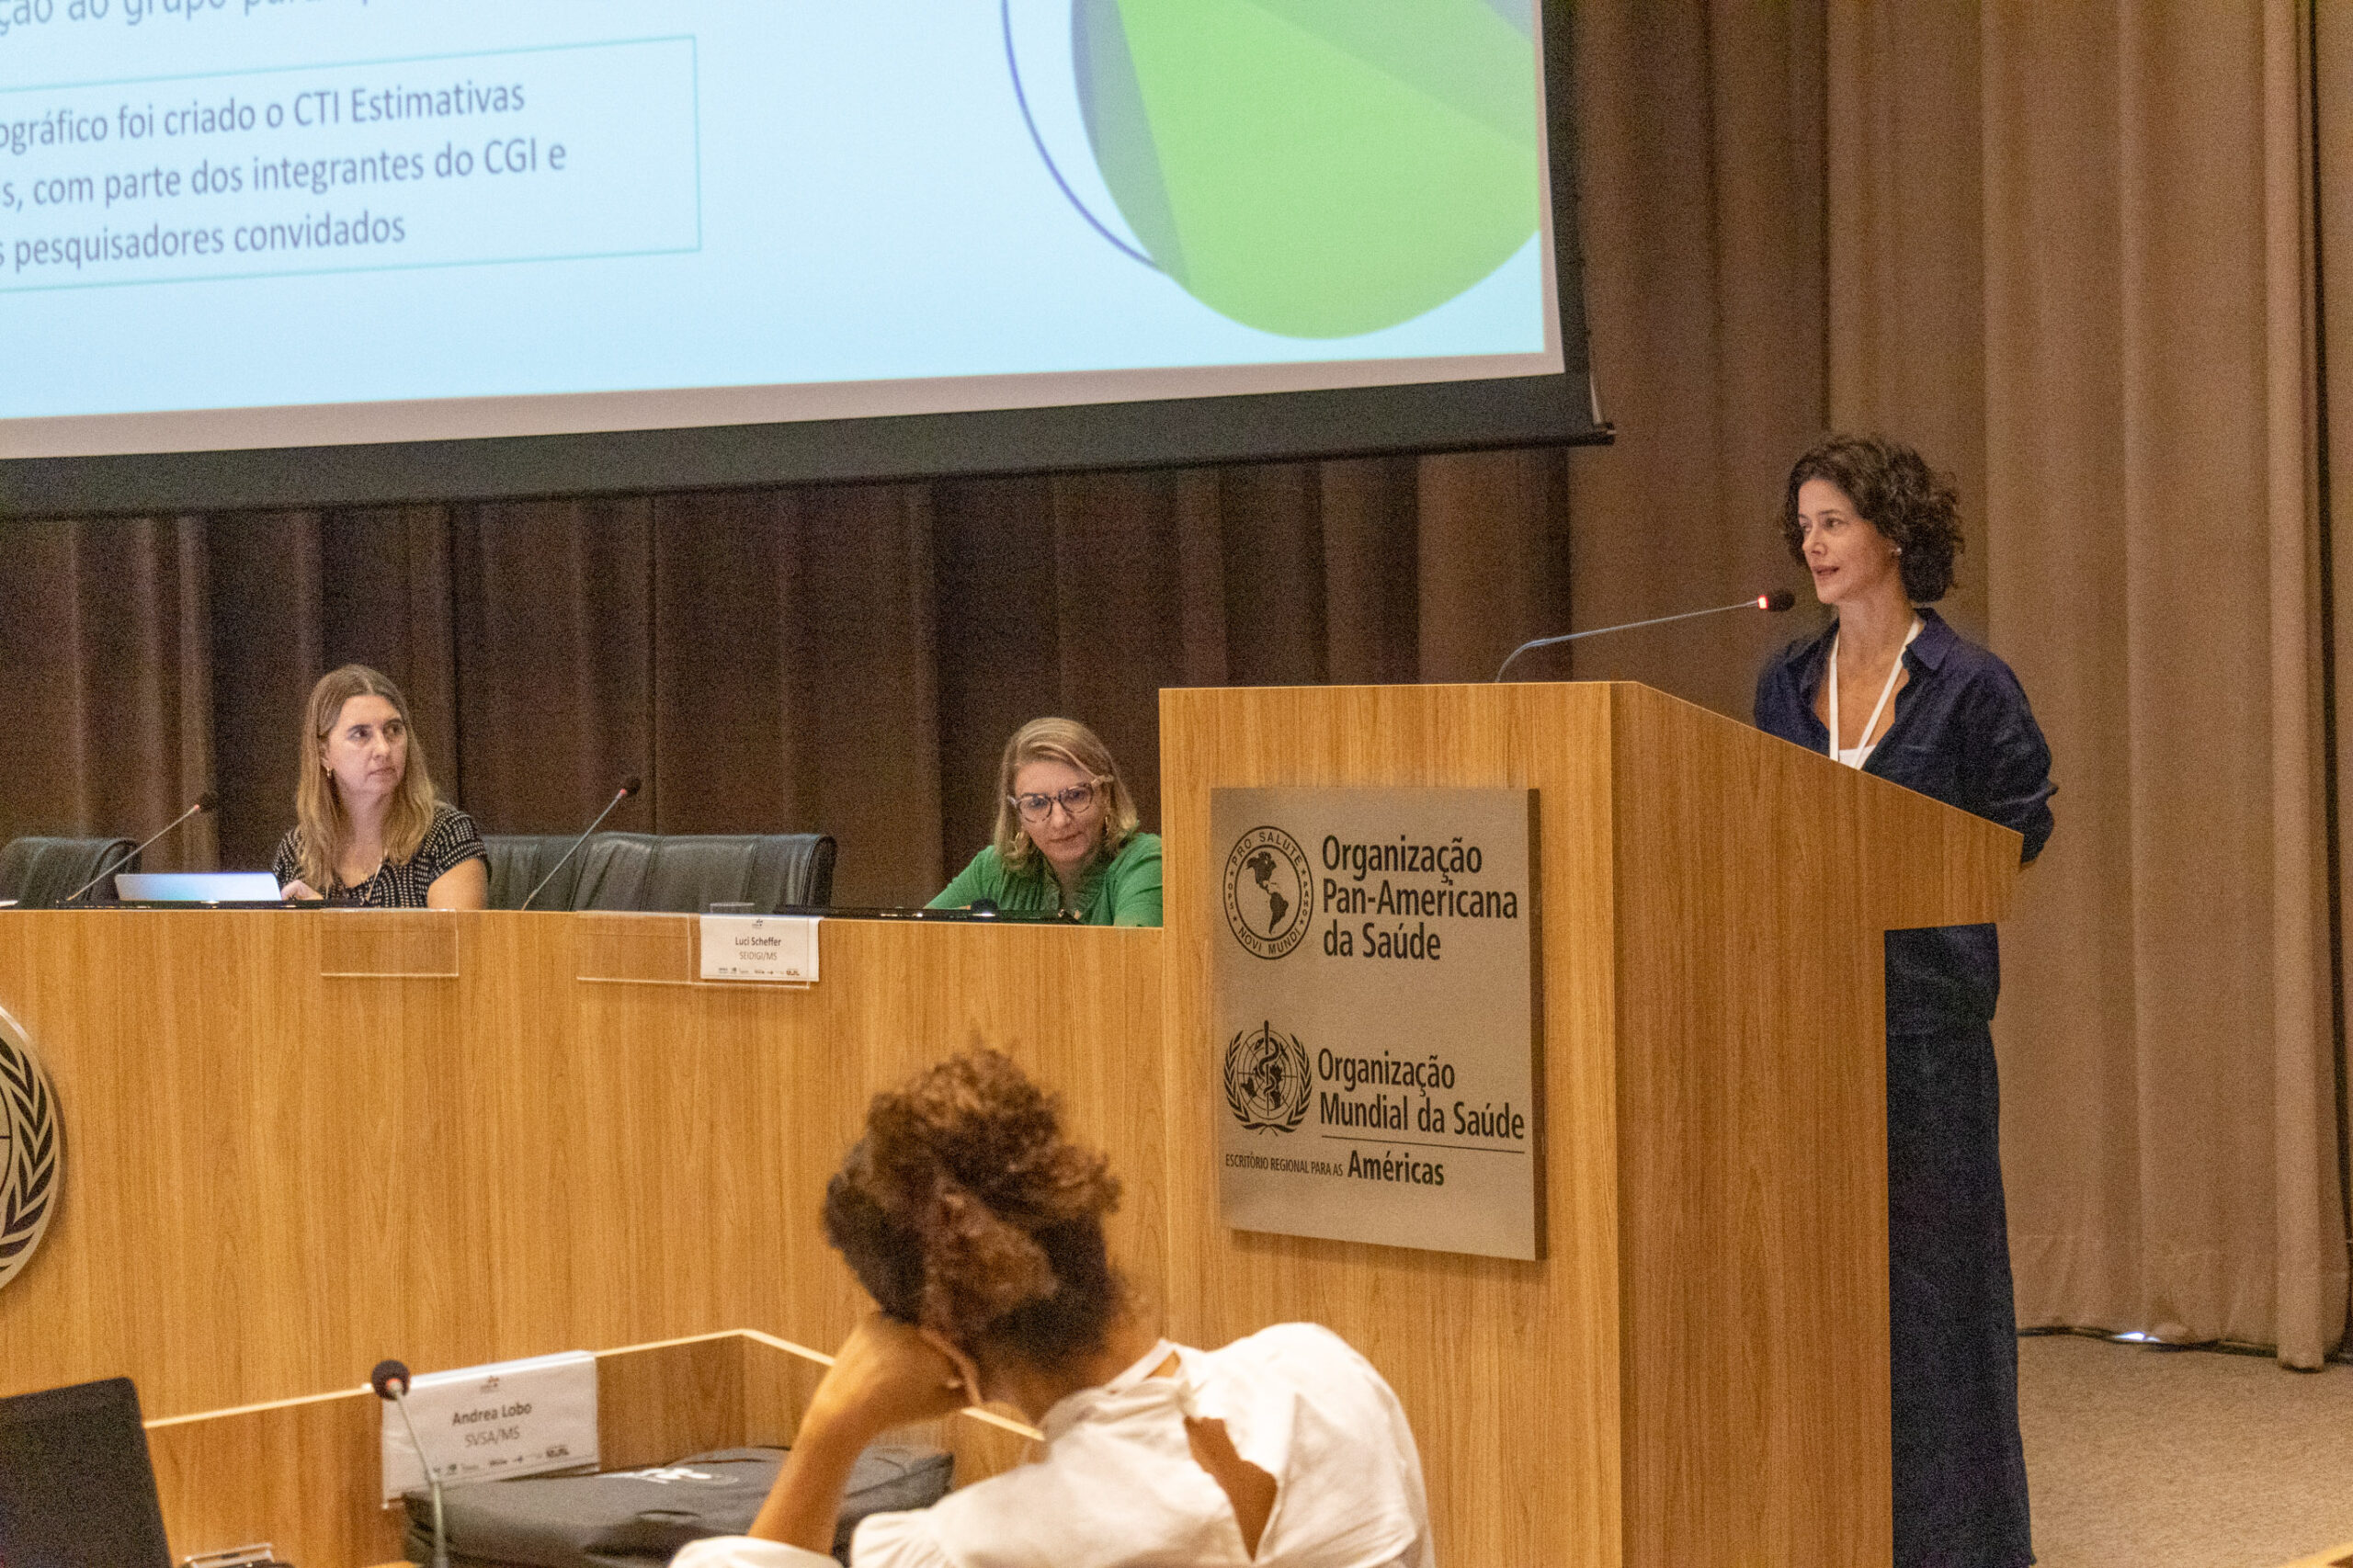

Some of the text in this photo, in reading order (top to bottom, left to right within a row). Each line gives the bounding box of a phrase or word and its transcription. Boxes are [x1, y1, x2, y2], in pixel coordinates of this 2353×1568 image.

[119, 104, 153, 141] foi
[165, 97, 256, 135] criado
[267, 102, 284, 129] o
[294, 90, 339, 126] CTI
[352, 79, 525, 122] Estimativas
[33, 176, 94, 205] com
[105, 165, 181, 209] parte
[191, 158, 243, 195] dos
[253, 149, 424, 195] integrantes
[435, 141, 473, 178] do
[484, 138, 537, 175] CGI
[549, 142, 566, 170] e
[16, 222, 224, 274] pesquisadores
[234, 210, 405, 253] convidados
[1232, 832, 1302, 866] PRO SALUTE
[1322, 835, 1483, 883] Organização
[1323, 878, 1518, 919] Pan-Americana
[735, 937, 781, 947] Luci Scheffer
[1238, 926, 1302, 955] NOVI MUNDI
[1324, 920, 1441, 960] da Saúde
[1318, 1048, 1455, 1096] Organização
[1320, 1092, 1525, 1140] Mundial da Saúde
[1225, 1150, 1445, 1186] ESCRITÓRIO REGIONAL PARA AS Américas
[452, 1402, 532, 1426] Andrea Lobo
[464, 1426, 520, 1448] SVSA/MS
